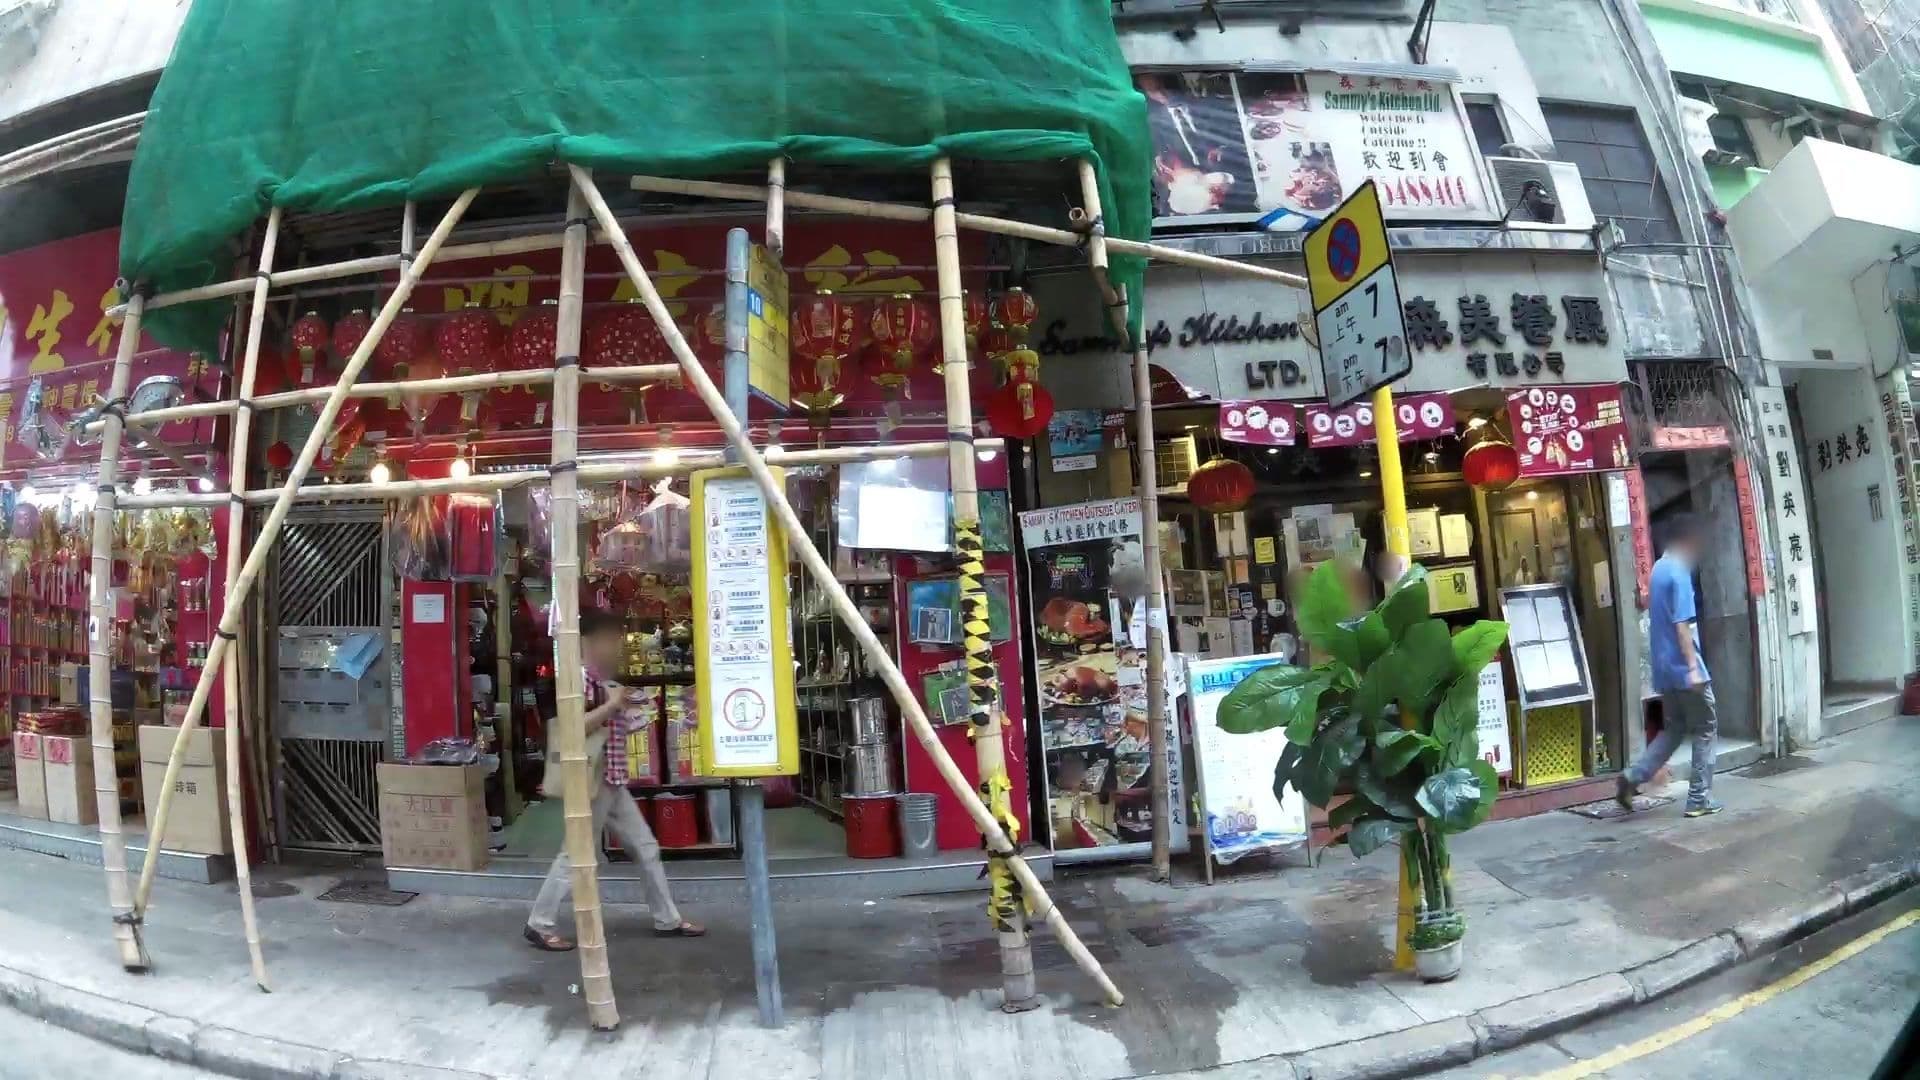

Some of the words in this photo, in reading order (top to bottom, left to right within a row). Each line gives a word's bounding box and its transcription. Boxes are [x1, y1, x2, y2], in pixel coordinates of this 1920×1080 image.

[1324, 90, 1377, 112] Sammy's
[751, 293, 761, 315] 10
[1335, 301, 1349, 319] am
[1365, 282, 1379, 318] 7
[1180, 311, 1300, 347] Kitchen
[1335, 315, 1357, 342] 上午
[1343, 354, 1358, 370] pm
[1374, 336, 1388, 373] 7
[1245, 360, 1307, 388] LTD.
[1342, 369, 1365, 390] 下午
[1776, 451, 1802, 562] 劉英亮
[1202, 671, 1239, 685] BLUE
